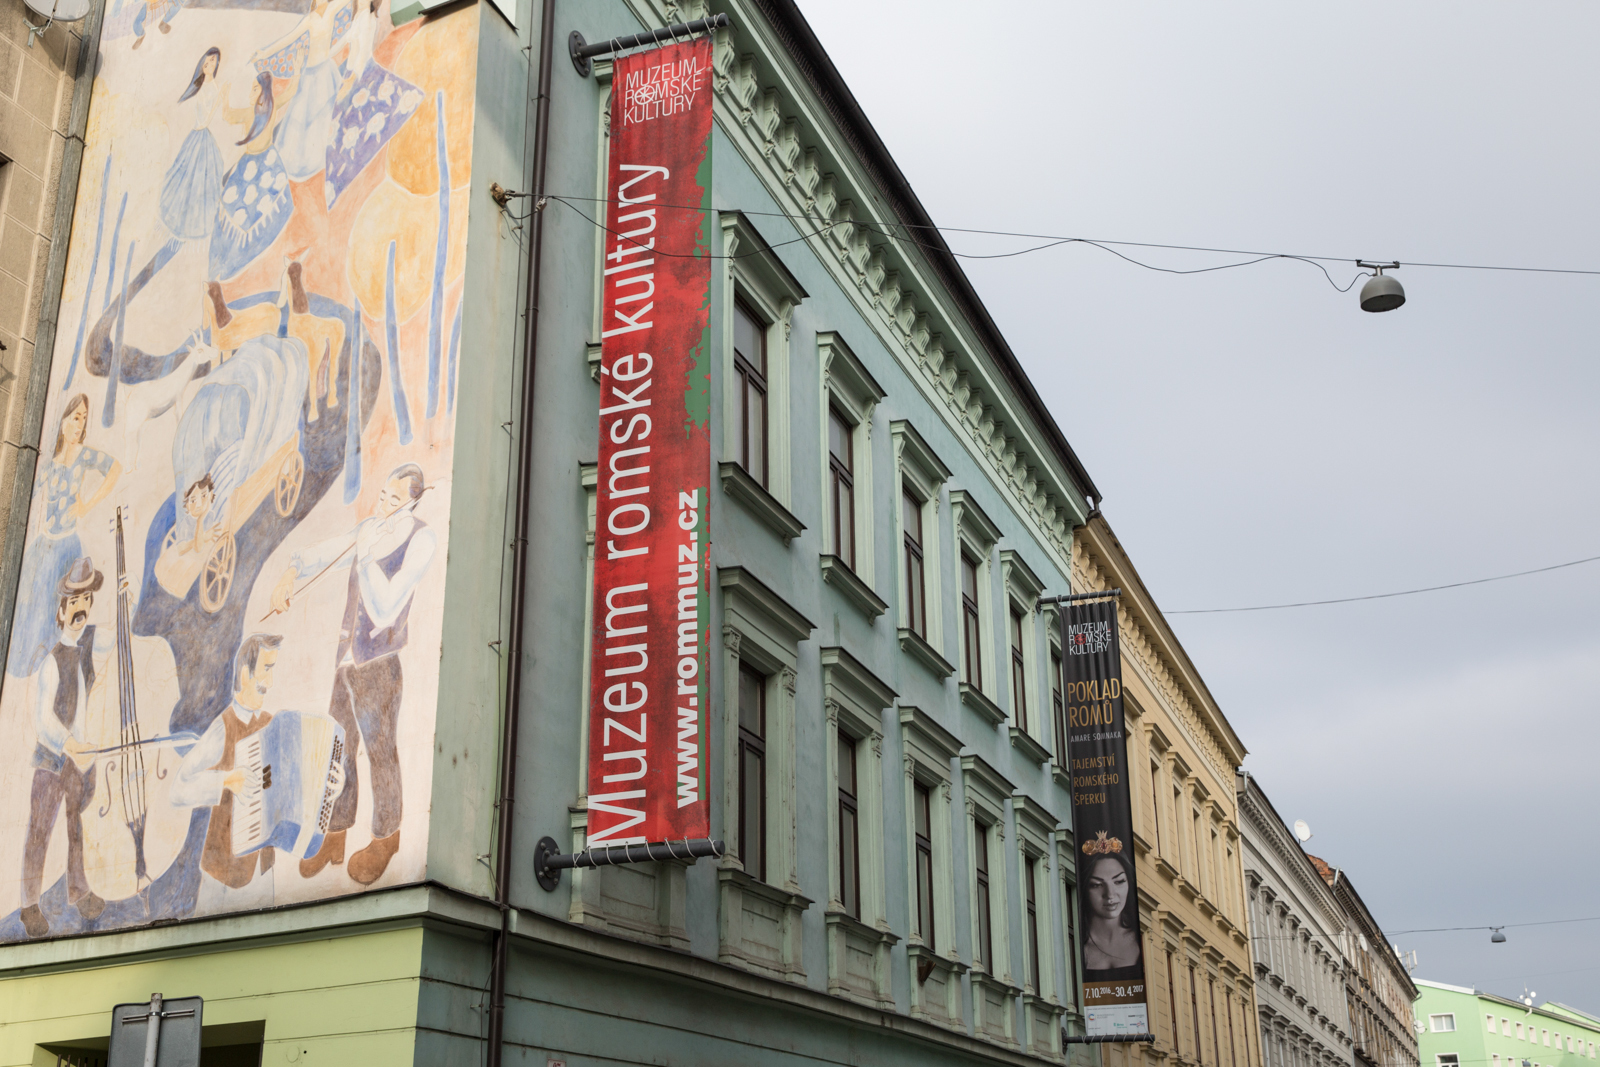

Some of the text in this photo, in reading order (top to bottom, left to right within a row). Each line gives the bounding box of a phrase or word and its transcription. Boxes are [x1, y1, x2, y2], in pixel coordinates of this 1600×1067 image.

[625, 56, 697, 91] MUZEUM
[624, 66, 706, 108] ROMSKÉ
[623, 92, 696, 126] KULTURY
[587, 164, 669, 849] Muzeum romské kultury
[1068, 621, 1109, 635] MUZEUM
[1068, 628, 1113, 645] ROMSKÉ
[677, 488, 698, 809] www.rommuz.cz
[1069, 641, 1109, 655] KULTURY
[1067, 678, 1120, 703] POKLAD
[1069, 699, 1113, 728] ROMŮ
[1070, 733, 1091, 742] AMARE
[1071, 753, 1115, 770] TAJEMSTVÍ
[1073, 771, 1119, 788] ROMSKÉHO
[1074, 792, 1106, 806] ŠPERKU
